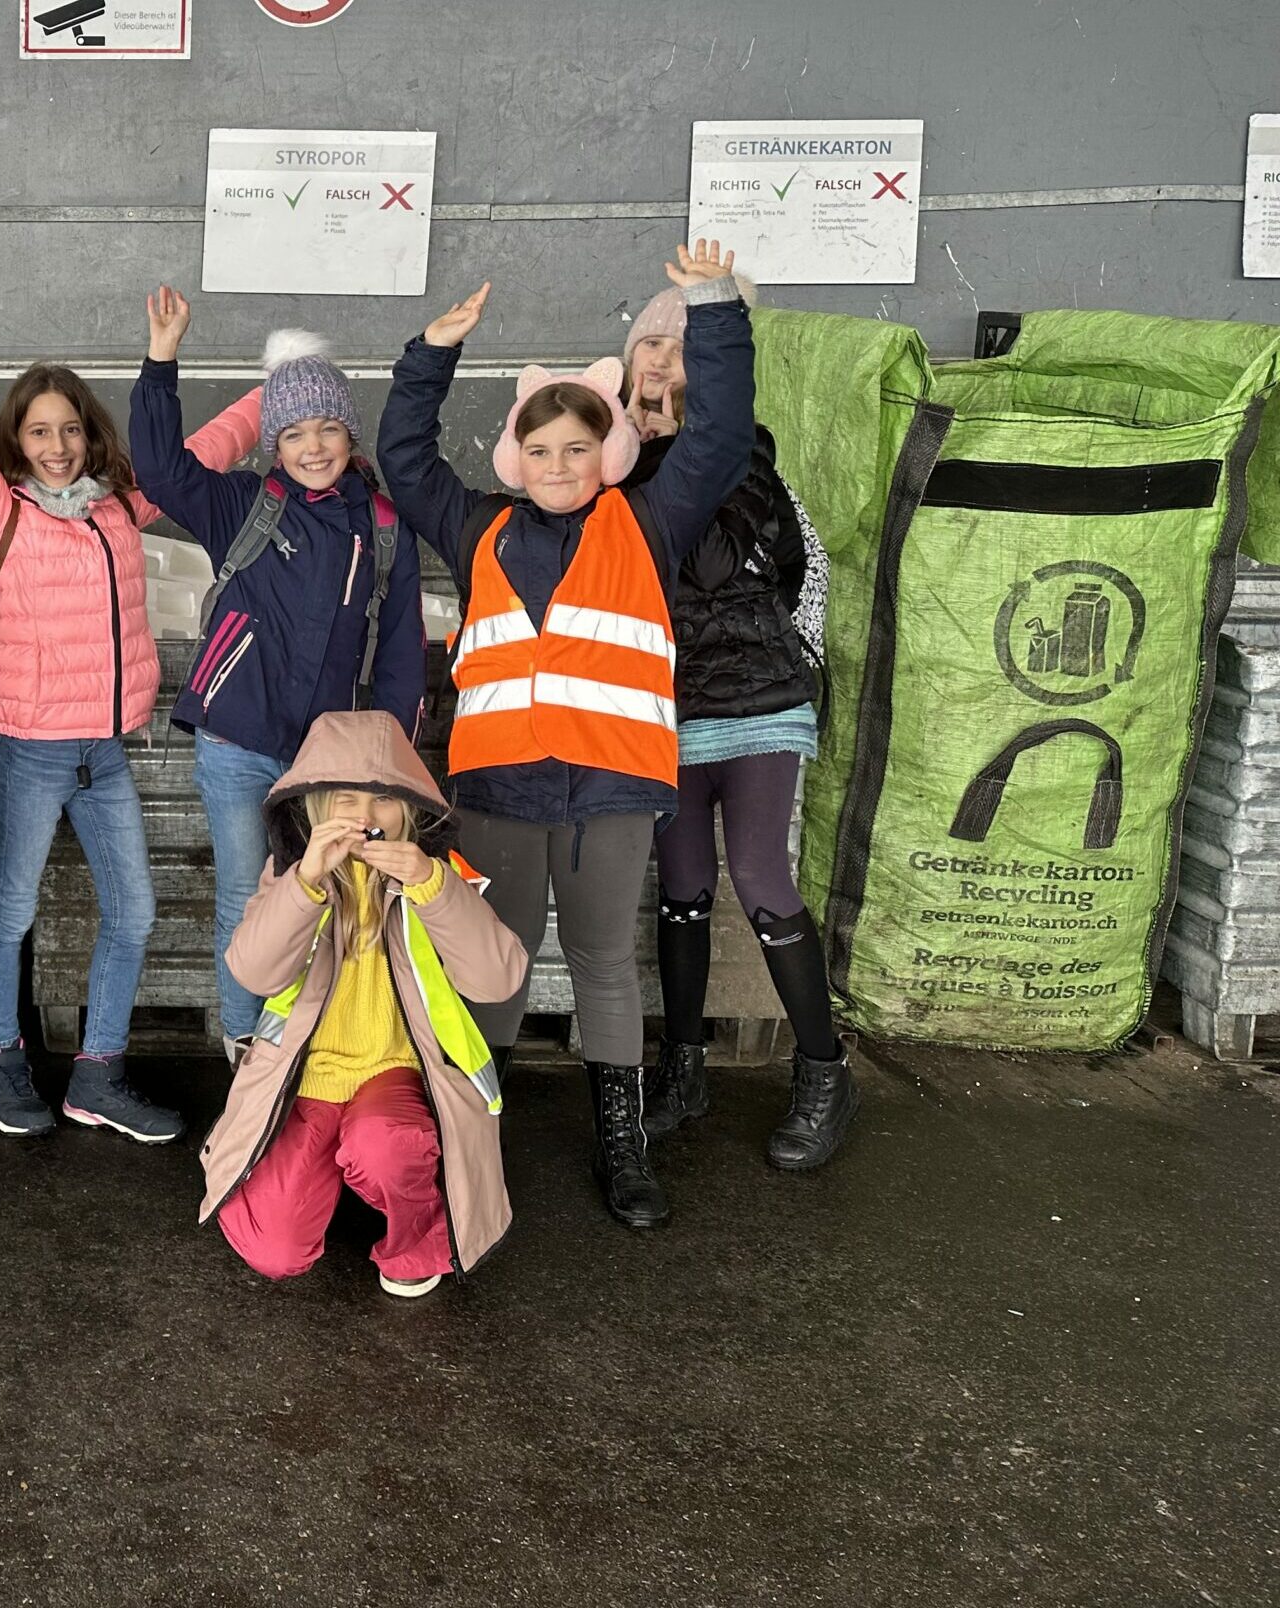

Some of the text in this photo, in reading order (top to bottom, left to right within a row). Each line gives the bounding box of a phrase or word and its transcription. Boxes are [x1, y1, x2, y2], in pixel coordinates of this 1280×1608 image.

[114, 11, 177, 19] Dieser Bereich ist
[724, 138, 892, 156] GETRÄNKEKARTON
[275, 150, 367, 166] STYROPOR
[224, 188, 371, 200] RICHTIG FALSCH
[710, 180, 862, 191] RICHTIG FALSCH
[908, 851, 1145, 882] Getränkekarton-
[959, 881, 1095, 912] Recycling
[920, 909, 1118, 930] getraenkekarton.ch
[911, 947, 1104, 979] Recyclage des
[998, 977, 1014, 997] à
[1023, 981, 1118, 1000] boisson
